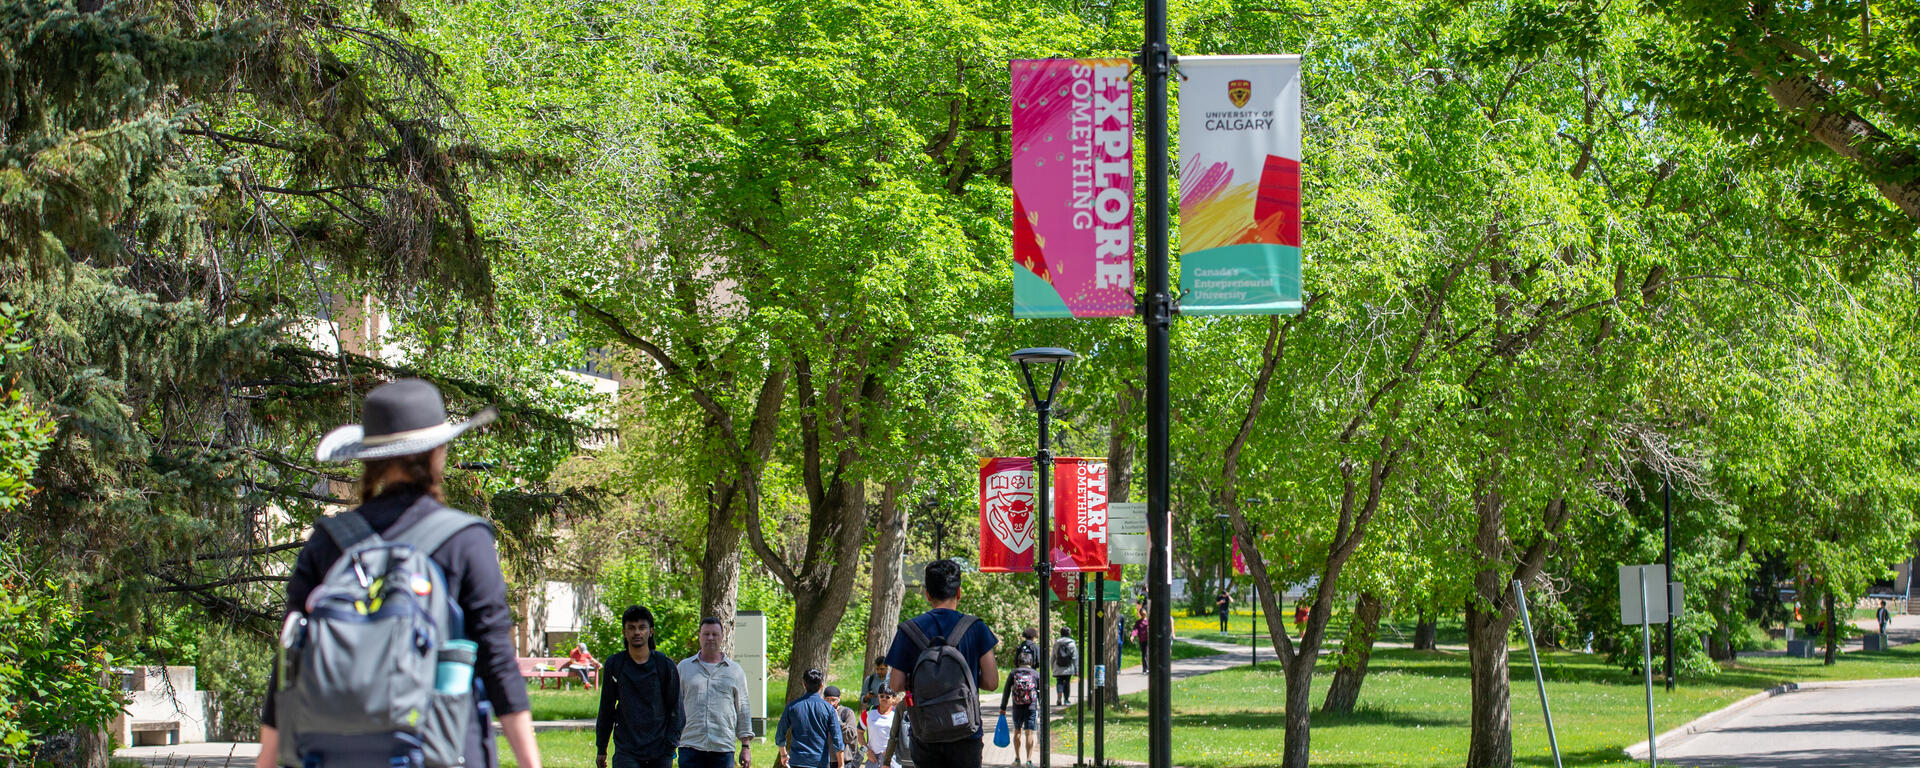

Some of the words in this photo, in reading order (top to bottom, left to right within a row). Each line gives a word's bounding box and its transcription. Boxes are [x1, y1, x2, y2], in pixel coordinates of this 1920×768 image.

[1205, 119, 1274, 131] CALGARY
[1072, 65, 1092, 230] SOMETHING
[1095, 63, 1130, 289] EXPLORE
[1194, 267, 1239, 277] Canada's
[1194, 278, 1274, 290] Entrepreneurial
[1194, 290, 1247, 301] University
[1078, 460, 1087, 534] SOMETHING
[1087, 460, 1106, 544] START
